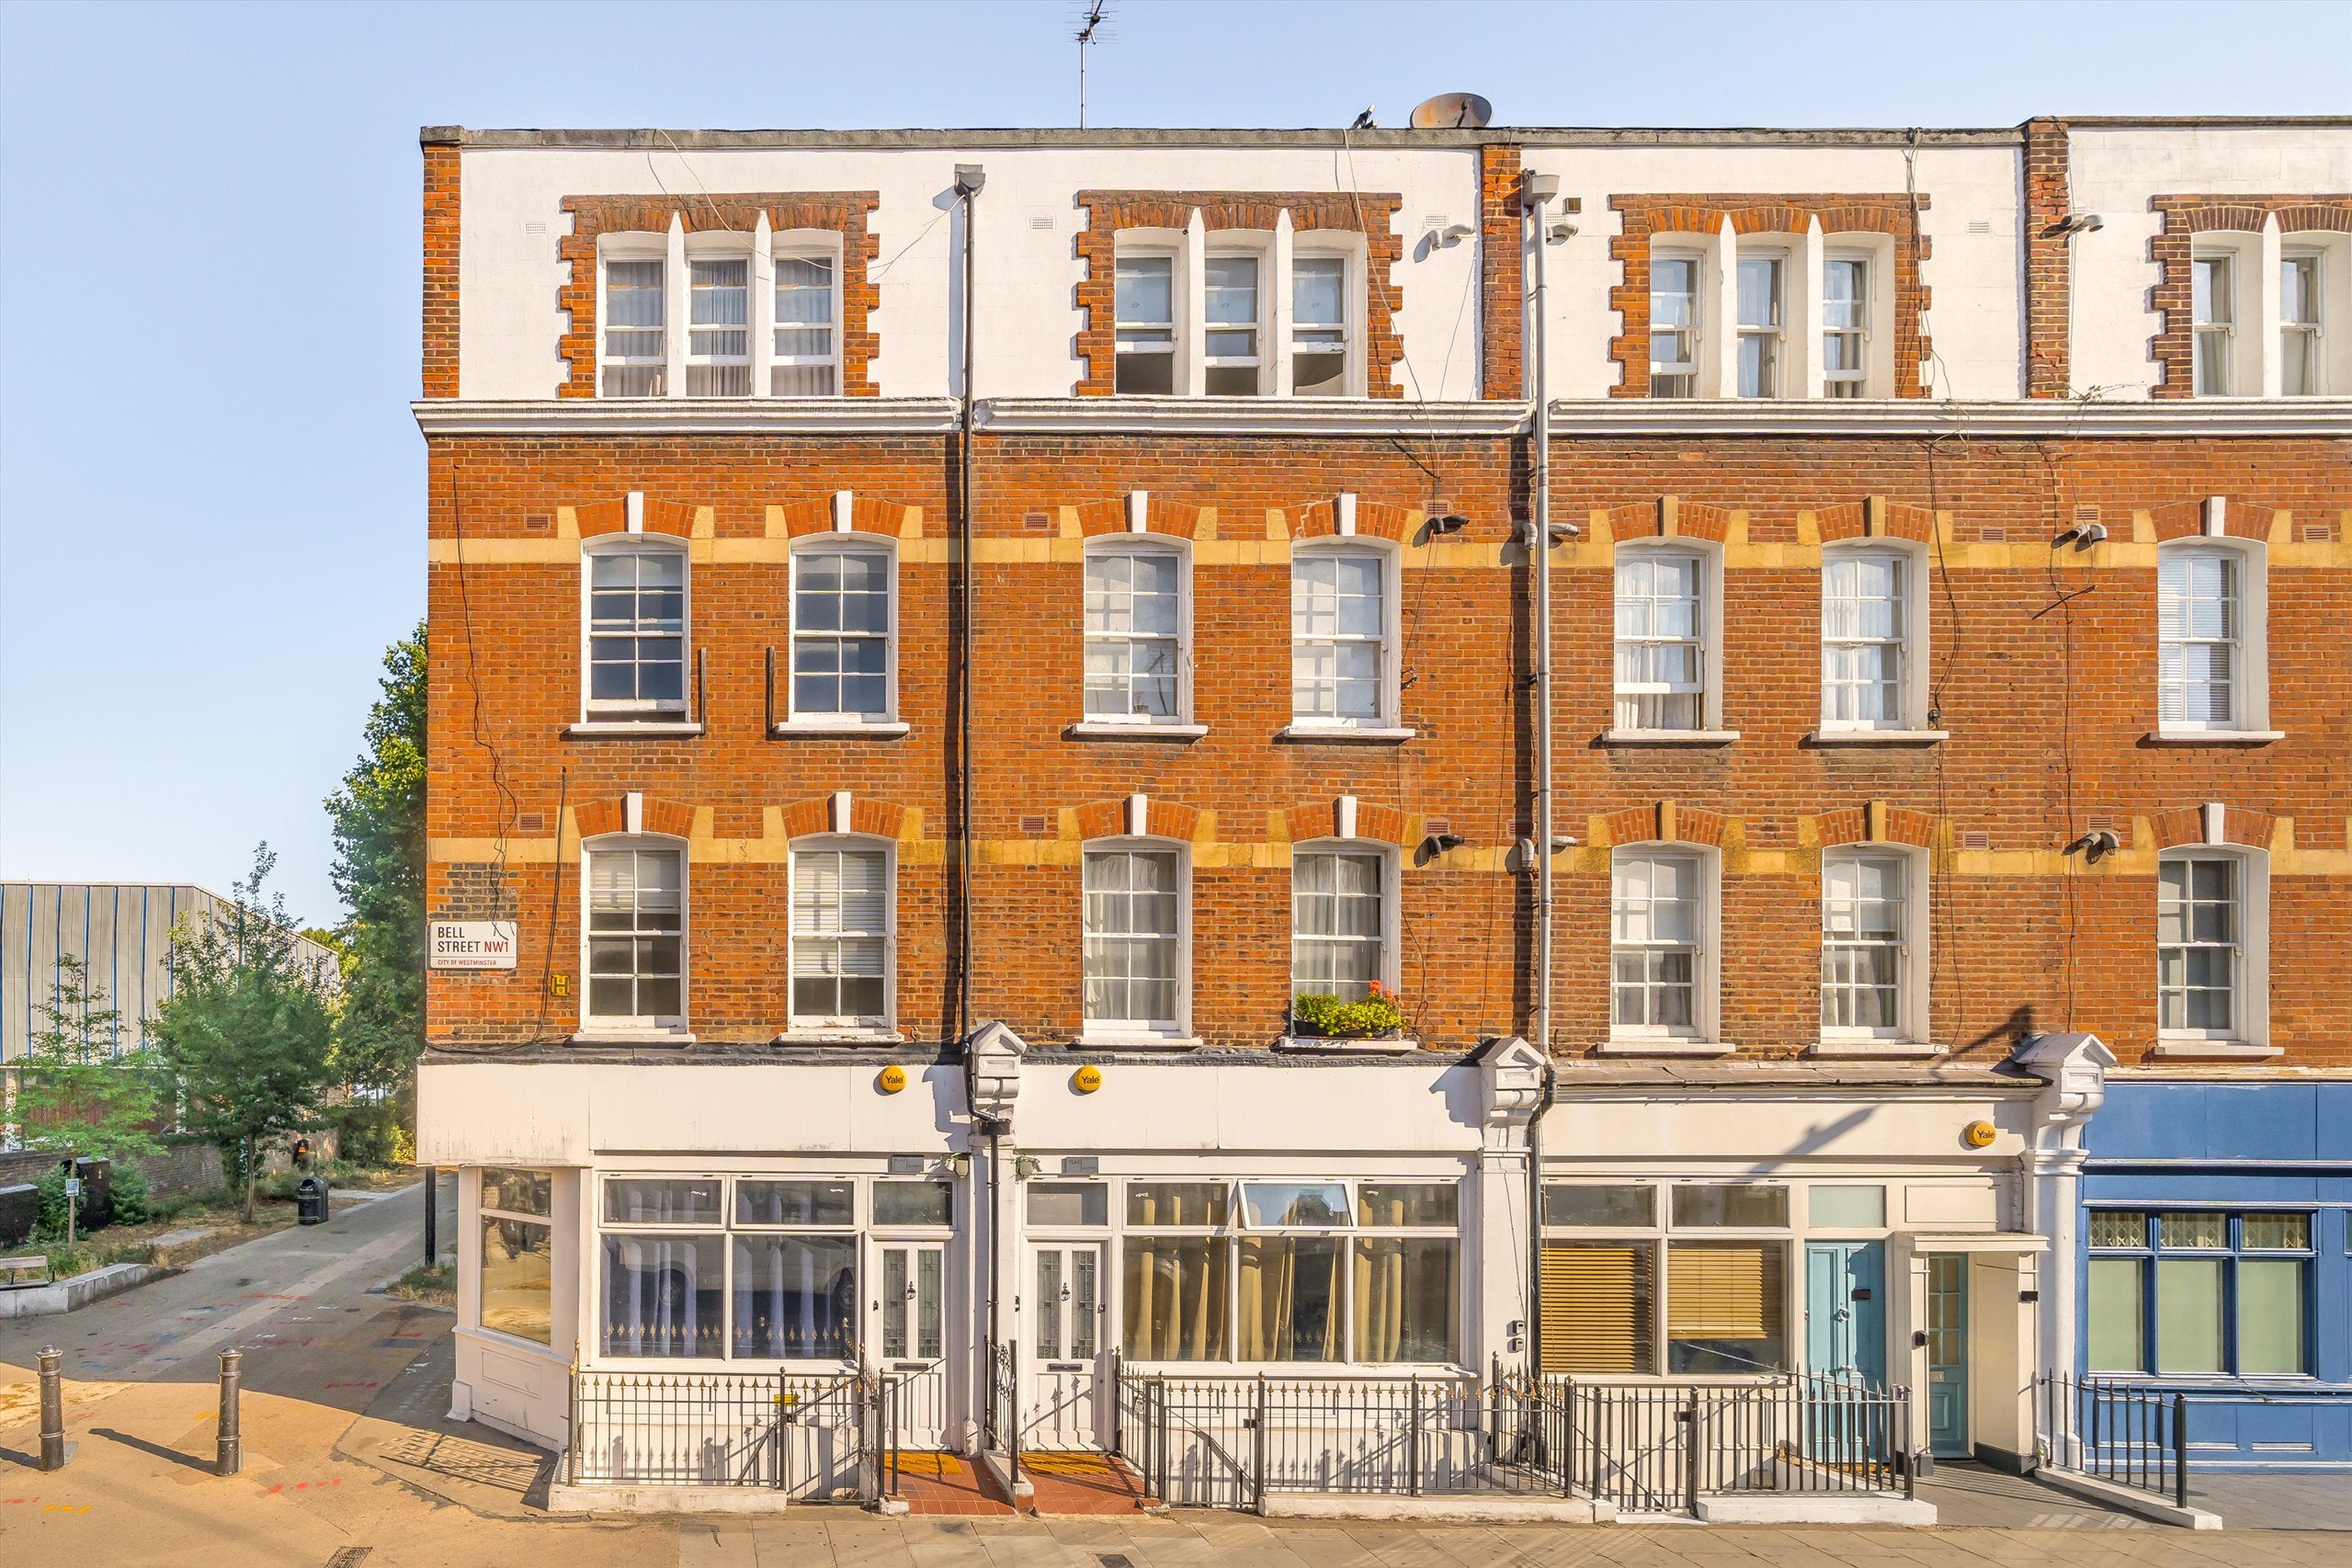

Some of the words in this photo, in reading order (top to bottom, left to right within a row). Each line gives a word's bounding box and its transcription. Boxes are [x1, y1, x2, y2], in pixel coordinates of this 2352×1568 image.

[437, 926, 465, 938] BELL
[437, 940, 481, 953] STREET
[484, 940, 509, 953] NW1
[885, 1075, 903, 1084] Yale
[1081, 1075, 1099, 1084] Yale
